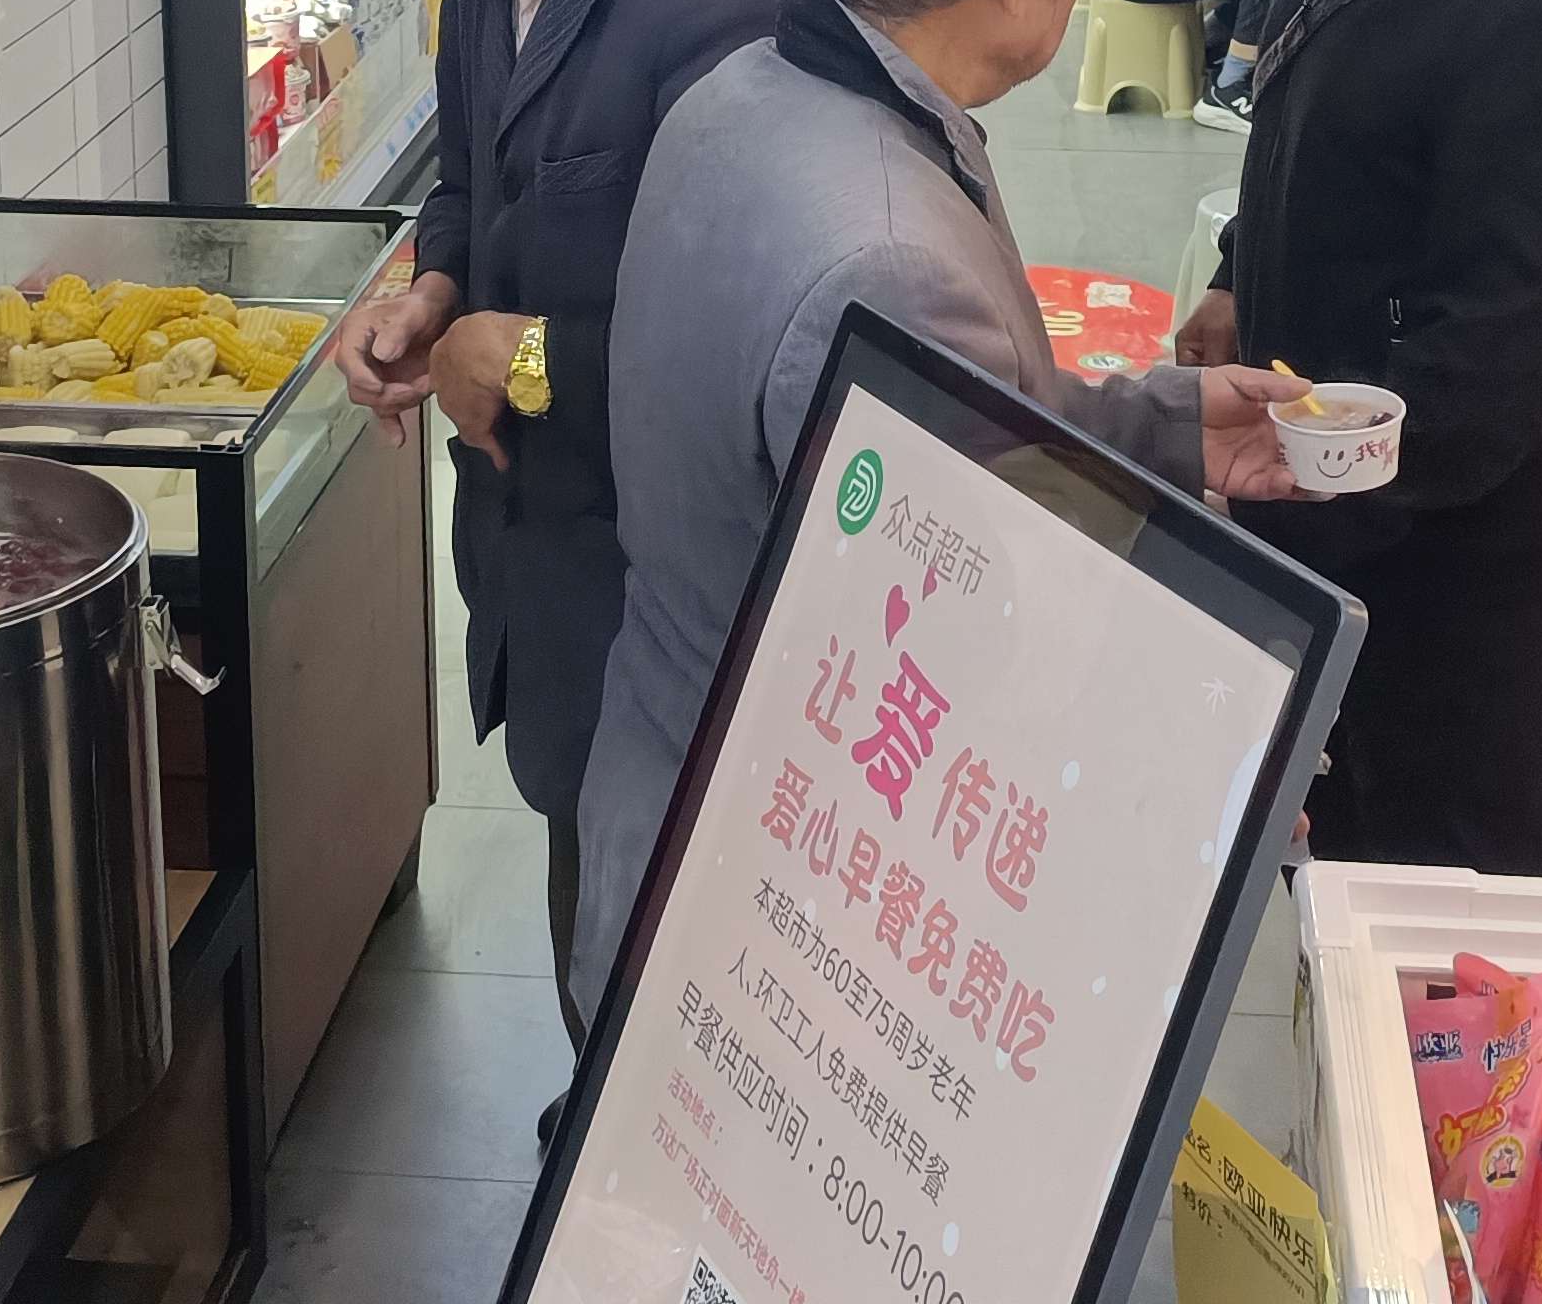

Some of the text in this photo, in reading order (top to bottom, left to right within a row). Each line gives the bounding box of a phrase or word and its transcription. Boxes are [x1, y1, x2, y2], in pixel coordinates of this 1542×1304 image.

[880, 493, 992, 597] 众点超市
[804, 634, 1049, 912] 让爱传递
[753, 876, 978, 1123] 本超市为60至75周岁老年
[759, 757, 1056, 1083] 爱心早餐免费吃
[676, 980, 965, 1304] 早餐供应时间：8:00-10:0
